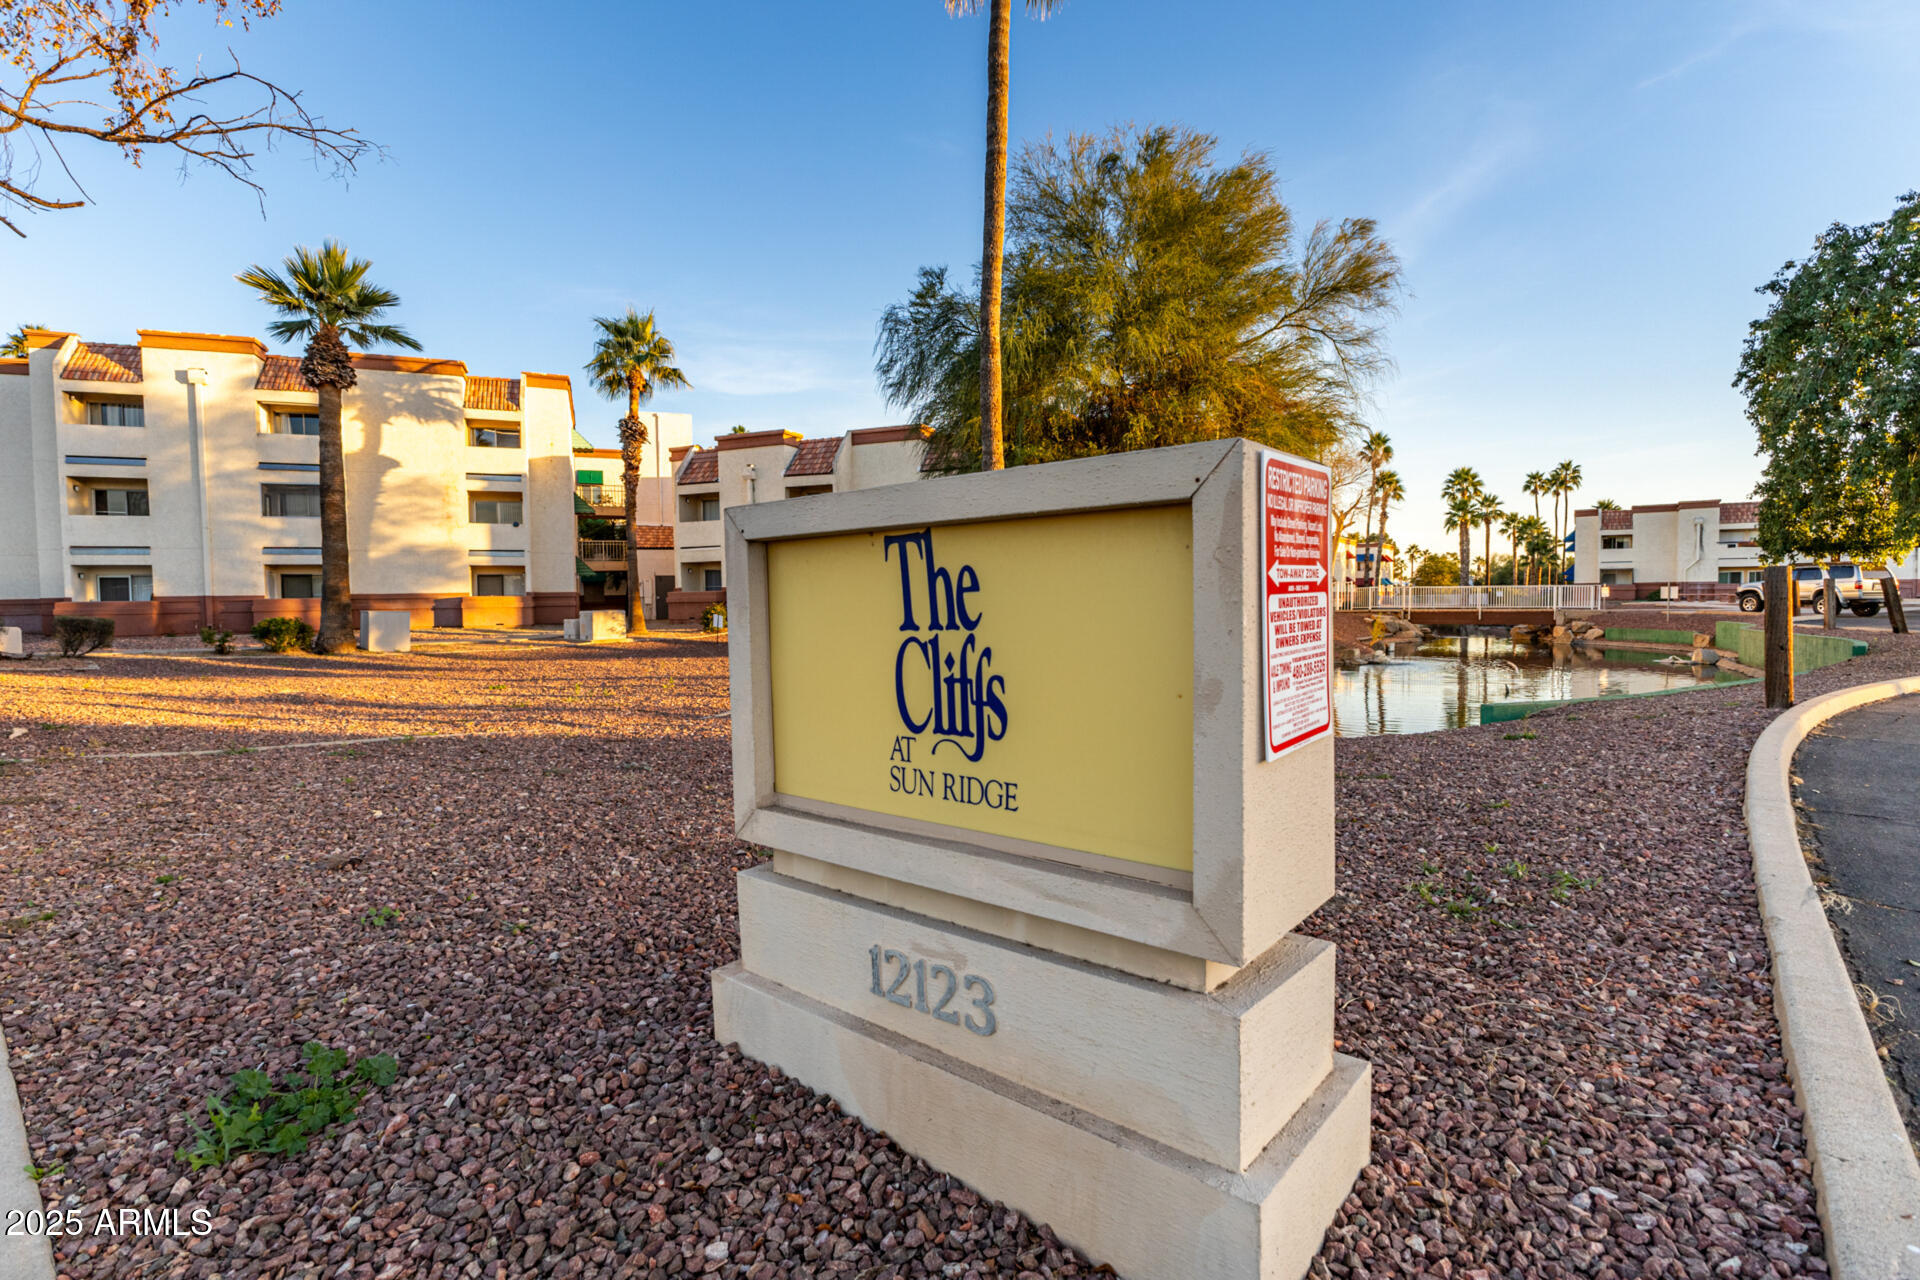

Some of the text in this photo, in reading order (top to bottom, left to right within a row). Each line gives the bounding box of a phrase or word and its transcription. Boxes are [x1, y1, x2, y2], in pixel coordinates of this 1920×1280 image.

[1268, 466, 1328, 500] RESTRICTED PARKING
[884, 527, 983, 631] The
[1276, 568, 1319, 579] TOW-AWAY ZONE
[1270, 607, 1326, 623] VEHICLES/VIOLATORS
[1278, 595, 1318, 609] UNAUTHORIZED
[1274, 619, 1322, 636] WILL BE TOWED AT
[1275, 631, 1322, 649] OWNERS EXPENSE
[895, 633, 1008, 762] Cliffs
[890, 736, 917, 763] AT
[890, 766, 1019, 811] SUN RIDGE
[869, 944, 997, 1037] 12123
